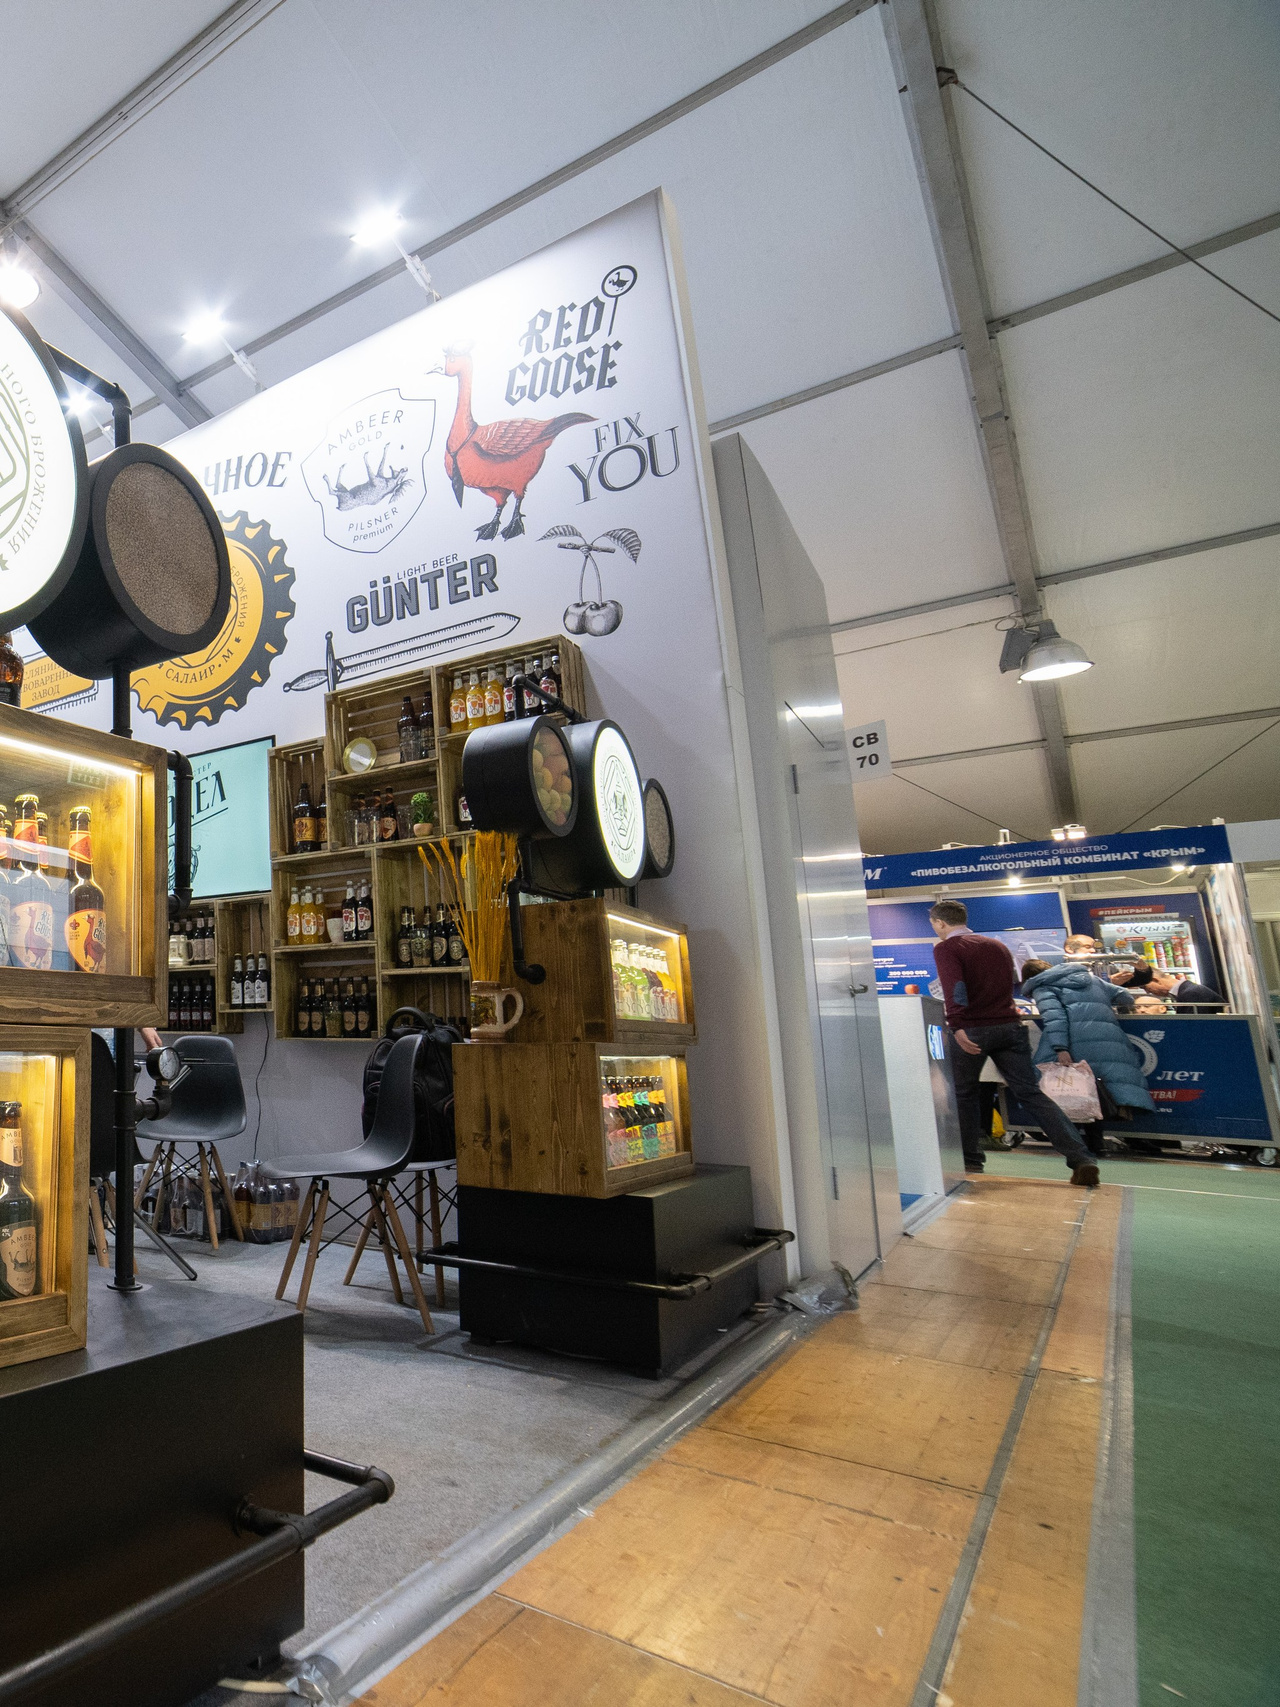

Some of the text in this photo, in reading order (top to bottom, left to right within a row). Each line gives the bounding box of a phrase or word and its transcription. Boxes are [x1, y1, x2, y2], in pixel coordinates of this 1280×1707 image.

[518, 295, 606, 357] RED
[505, 340, 623, 406] GOOSE
[328, 409, 404, 455] AMBEER
[348, 430, 383, 452] GOLD
[592, 411, 646, 454] FIX
[565, 425, 681, 505] YOU
[7, 434, 47, 555] БРОЖЕНИЯ
[347, 506, 399, 532] PILSNER
[352, 521, 394, 543] premium
[396, 552, 459, 580] LIGHT BEER
[345, 553, 499, 634] GÜNTER
[165, 663, 216, 685] САЛАИР
[31, 684, 61, 702] ЗАВОД
[856, 753, 880, 769] 70
[910, 845, 1206, 878] «ПИВОБЕЗАЛКОГОЛЬНЫЙ КОМБИНАТ «КРЫМ»
[979, 844, 1109, 862] АКЦИОНЕРНОЕ ОБЩЕСТВО
[1156, 1069, 1205, 1082] лет
